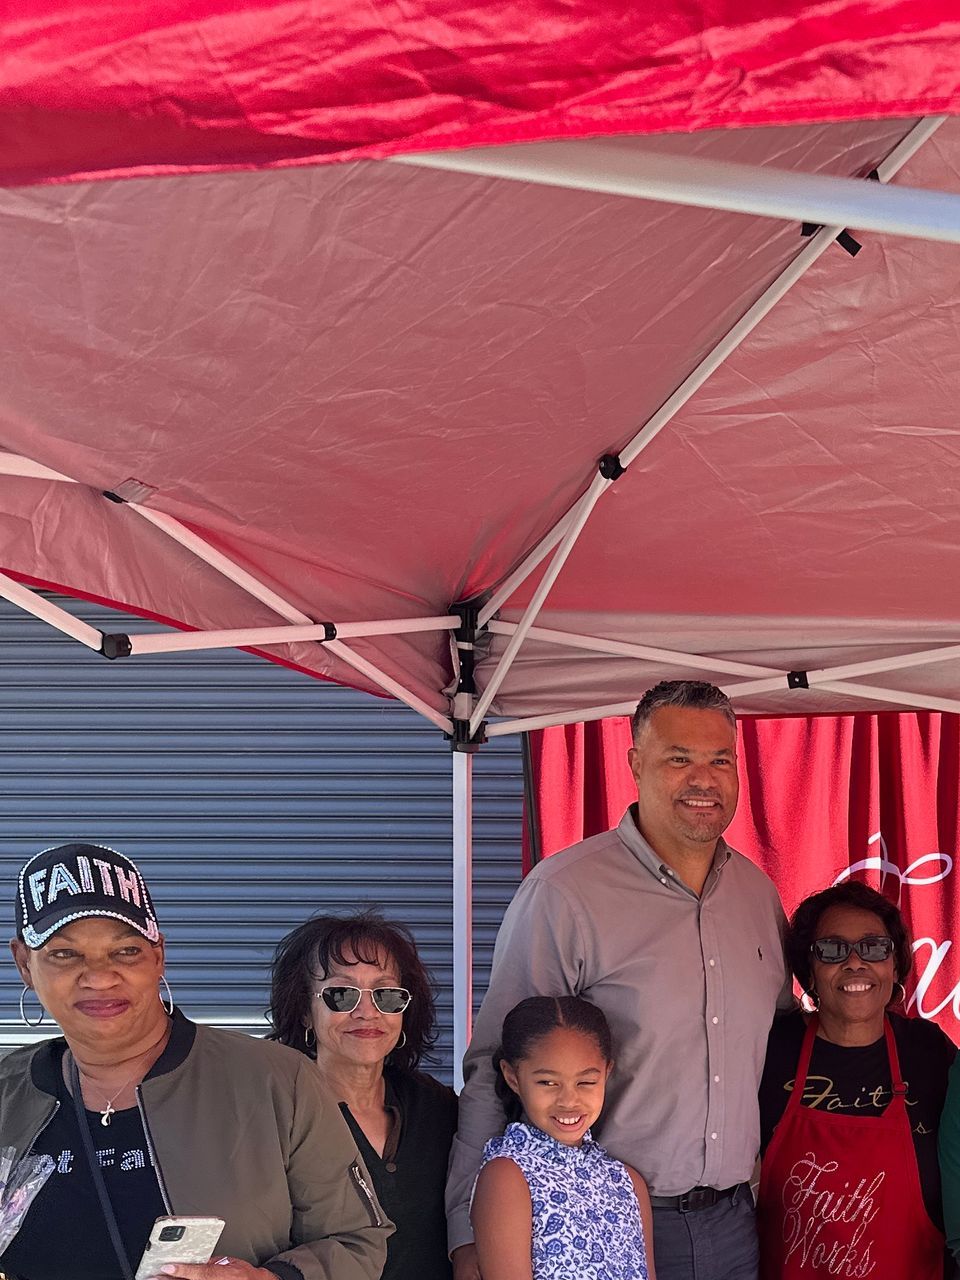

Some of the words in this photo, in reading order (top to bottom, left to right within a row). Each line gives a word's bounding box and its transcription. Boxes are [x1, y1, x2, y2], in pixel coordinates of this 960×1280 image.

[28, 856, 141, 912] FAITH
[782, 1152, 886, 1225] Faith
[782, 1207, 877, 1279] Works
